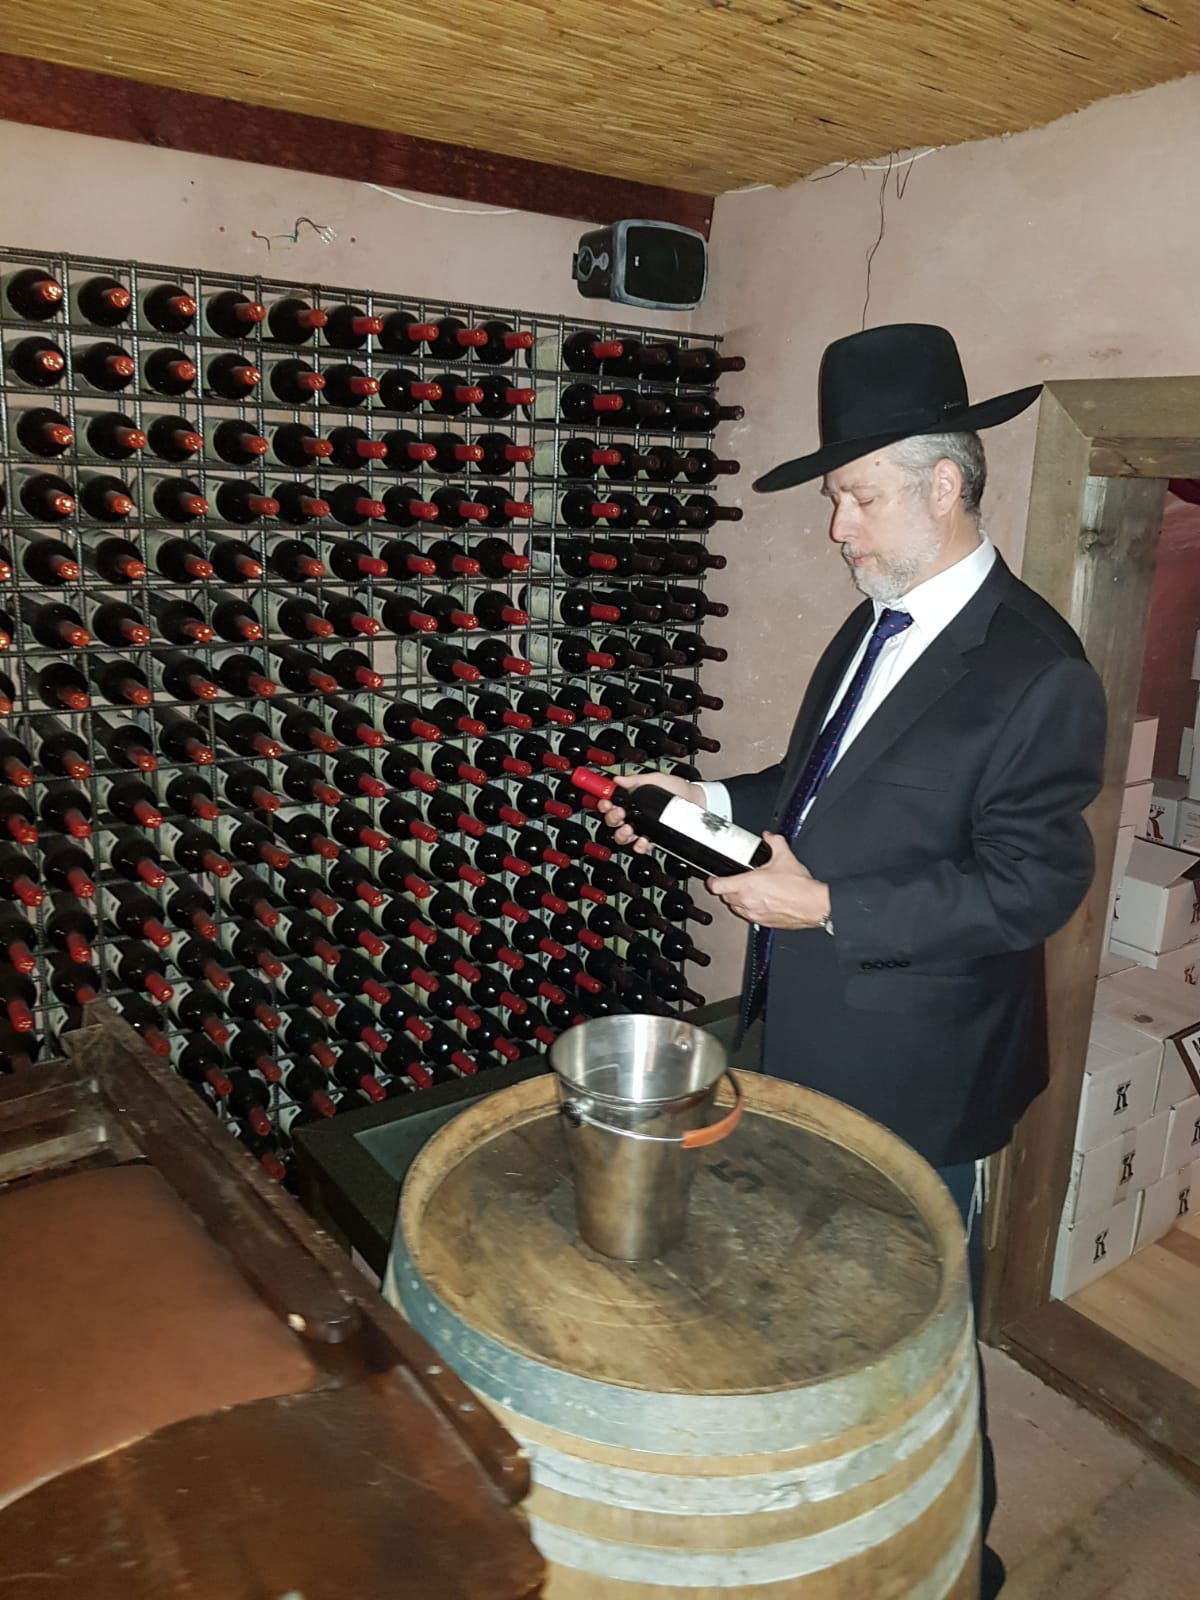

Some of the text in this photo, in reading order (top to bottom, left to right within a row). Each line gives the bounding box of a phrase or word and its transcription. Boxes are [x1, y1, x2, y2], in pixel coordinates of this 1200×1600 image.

[1113, 1080, 1131, 1115] K
[1120, 1149, 1136, 1185] K
[1176, 1185, 1191, 1218] K
[1093, 1228, 1109, 1264] K
